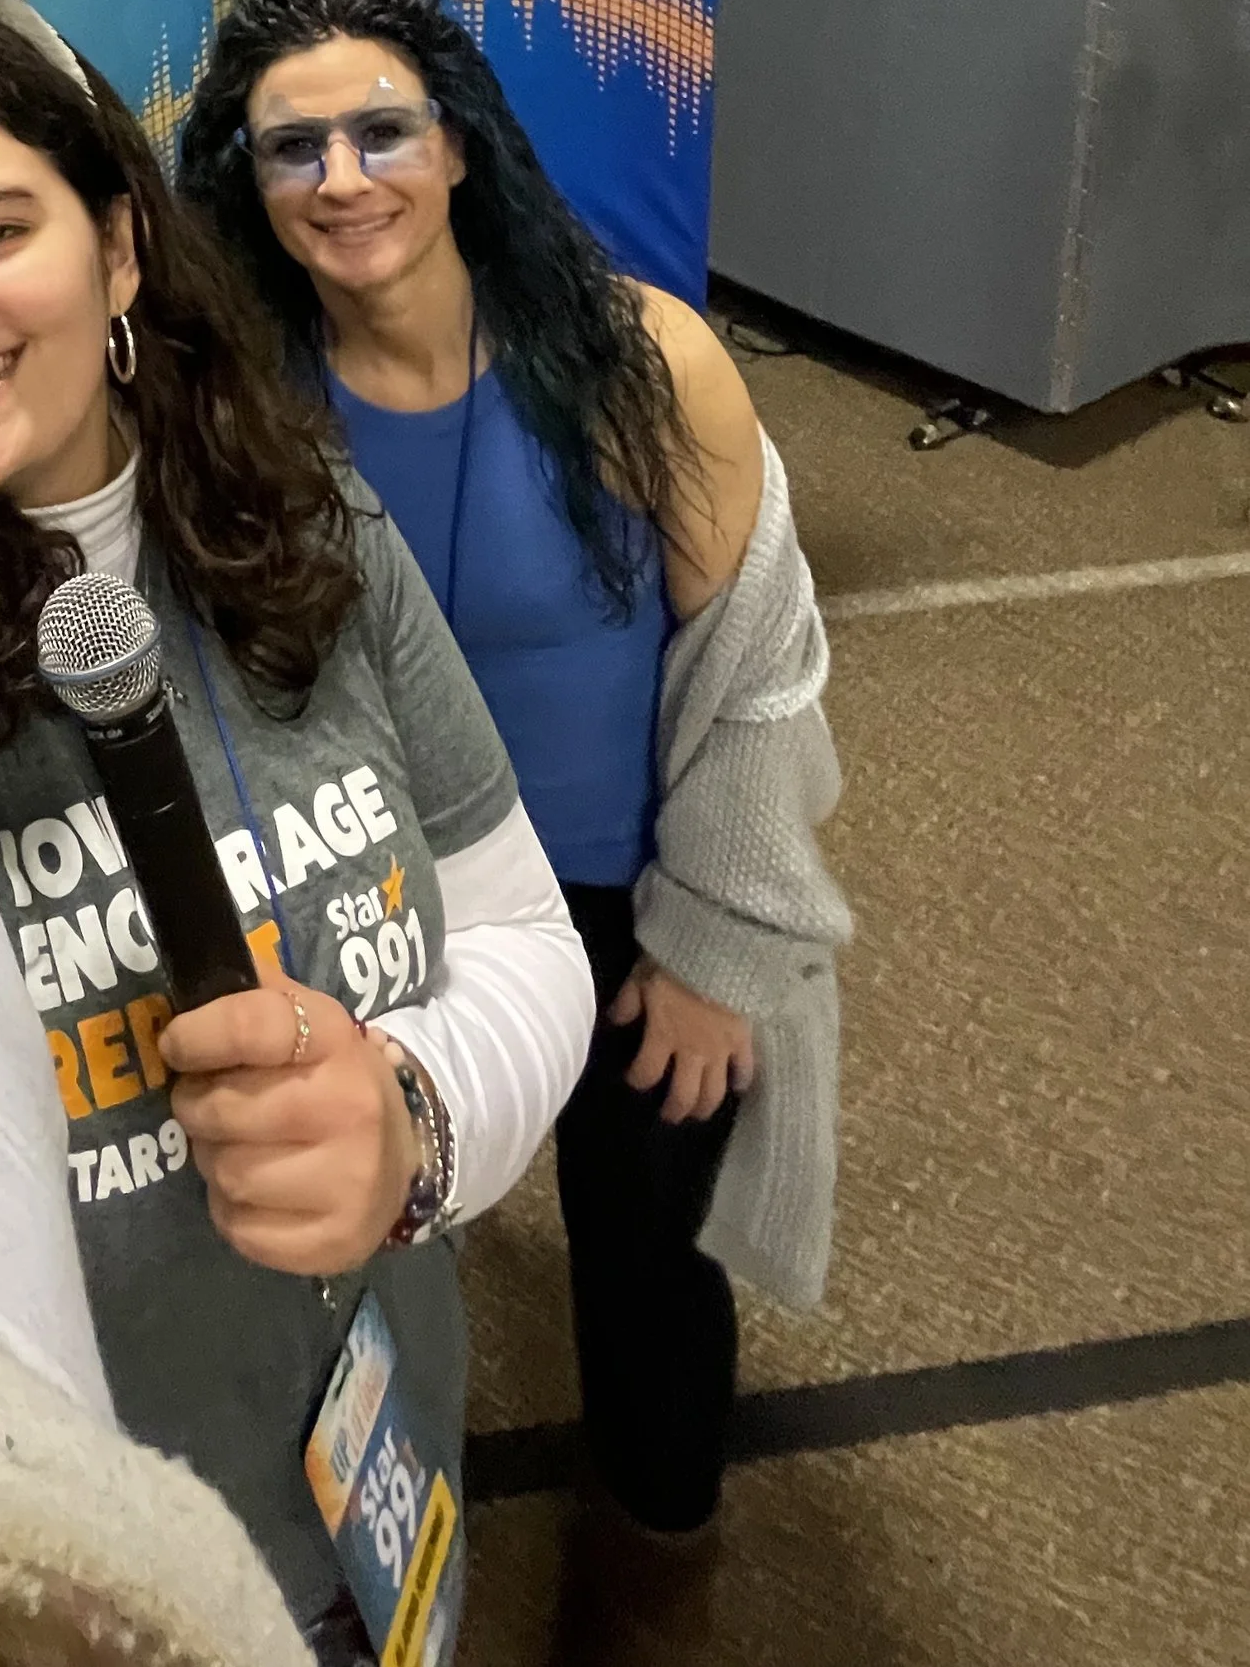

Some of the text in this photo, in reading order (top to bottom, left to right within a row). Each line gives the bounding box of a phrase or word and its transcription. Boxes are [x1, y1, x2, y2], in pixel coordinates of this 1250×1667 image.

[326, 886, 384, 941] Star
[339, 907, 427, 1022] 99.1
[361, 1426, 398, 1531] Star
